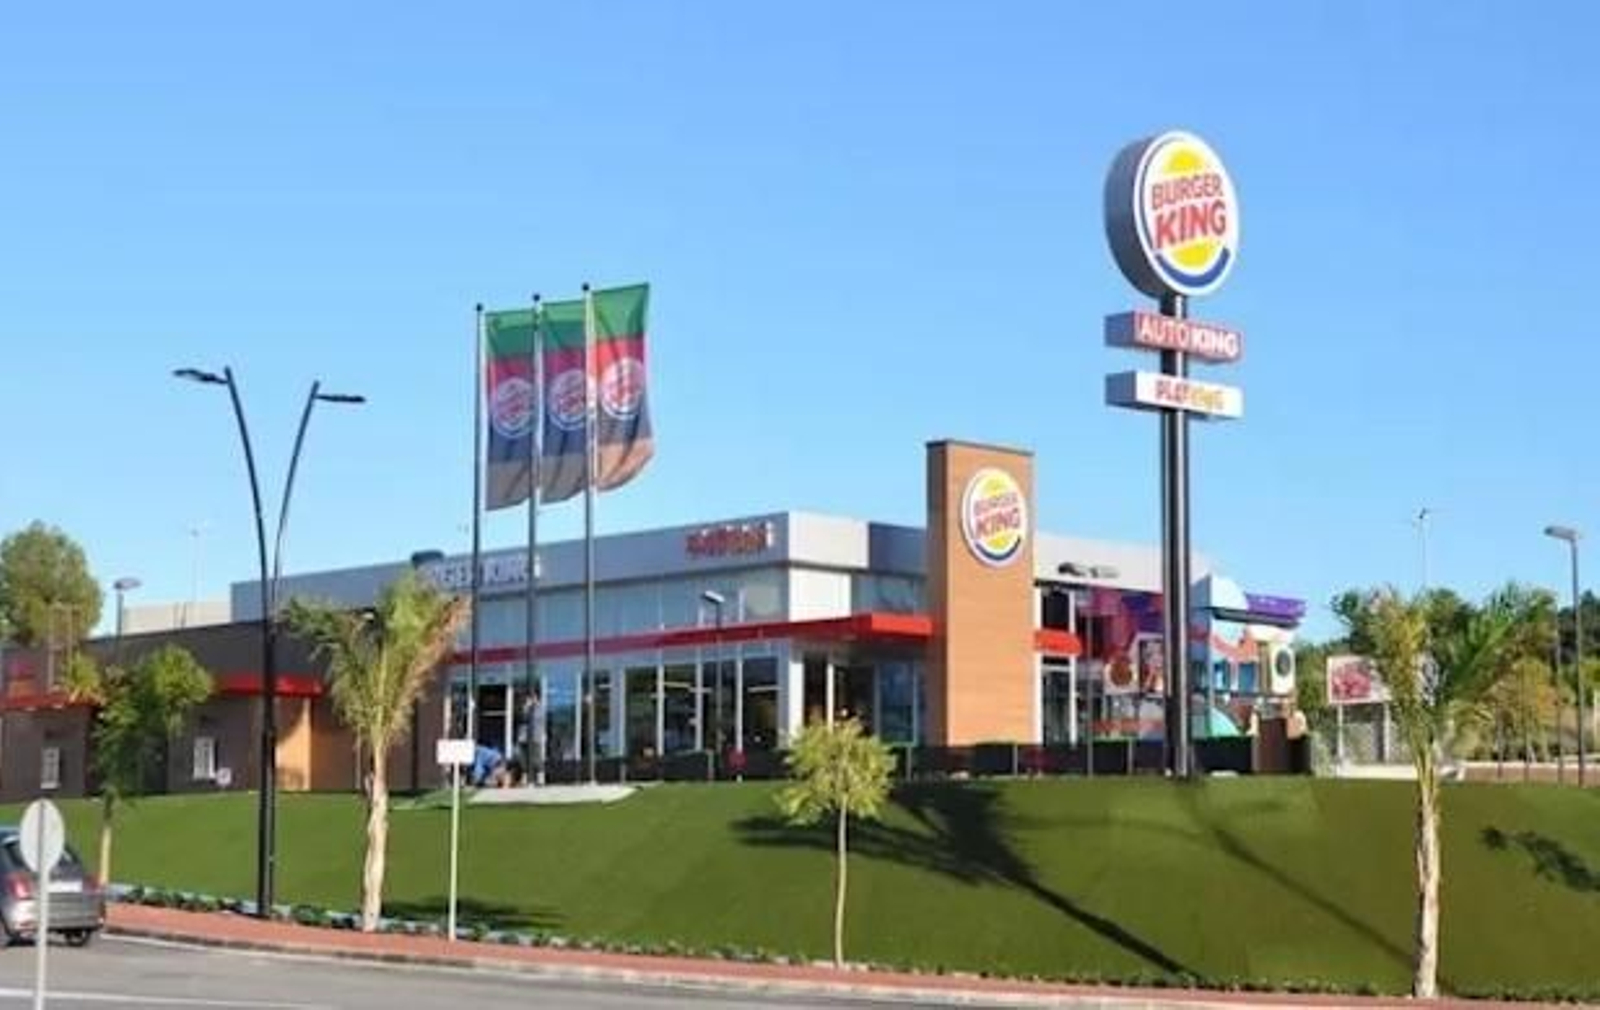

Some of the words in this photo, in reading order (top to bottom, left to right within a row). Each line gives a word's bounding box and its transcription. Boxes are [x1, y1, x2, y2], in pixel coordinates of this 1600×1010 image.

[1151, 174, 1223, 209] BURGER
[1154, 199, 1227, 248] KING
[1139, 314, 1189, 350] AUTO
[1190, 325, 1238, 357] KING
[976, 507, 1021, 540] KING
